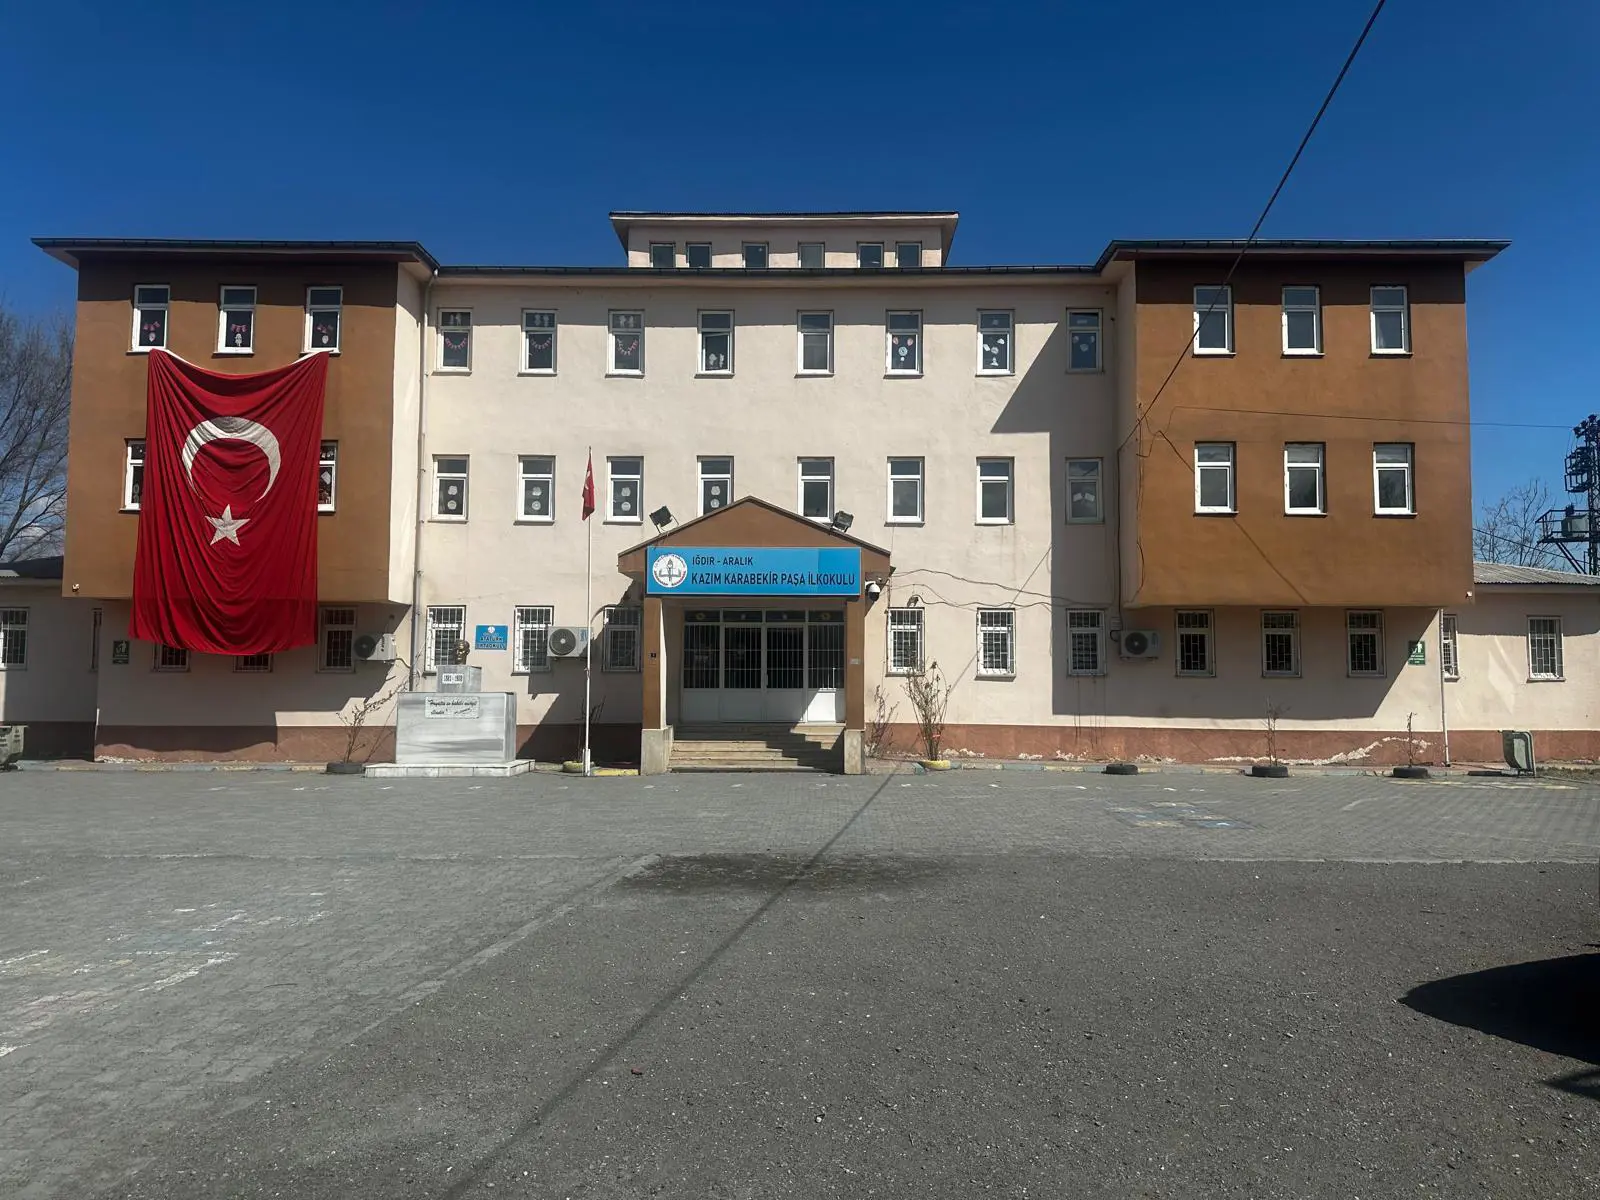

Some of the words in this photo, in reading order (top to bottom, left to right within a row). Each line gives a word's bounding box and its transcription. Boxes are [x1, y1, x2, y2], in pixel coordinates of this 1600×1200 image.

[692, 555, 715, 566] IĞDIR
[722, 556, 753, 566] ARALIK
[691, 573, 722, 585] KAZIM
[724, 571, 778, 585] KARABEKİR
[781, 573, 805, 586] PAŞA
[808, 572, 855, 585] İLKOKULU
